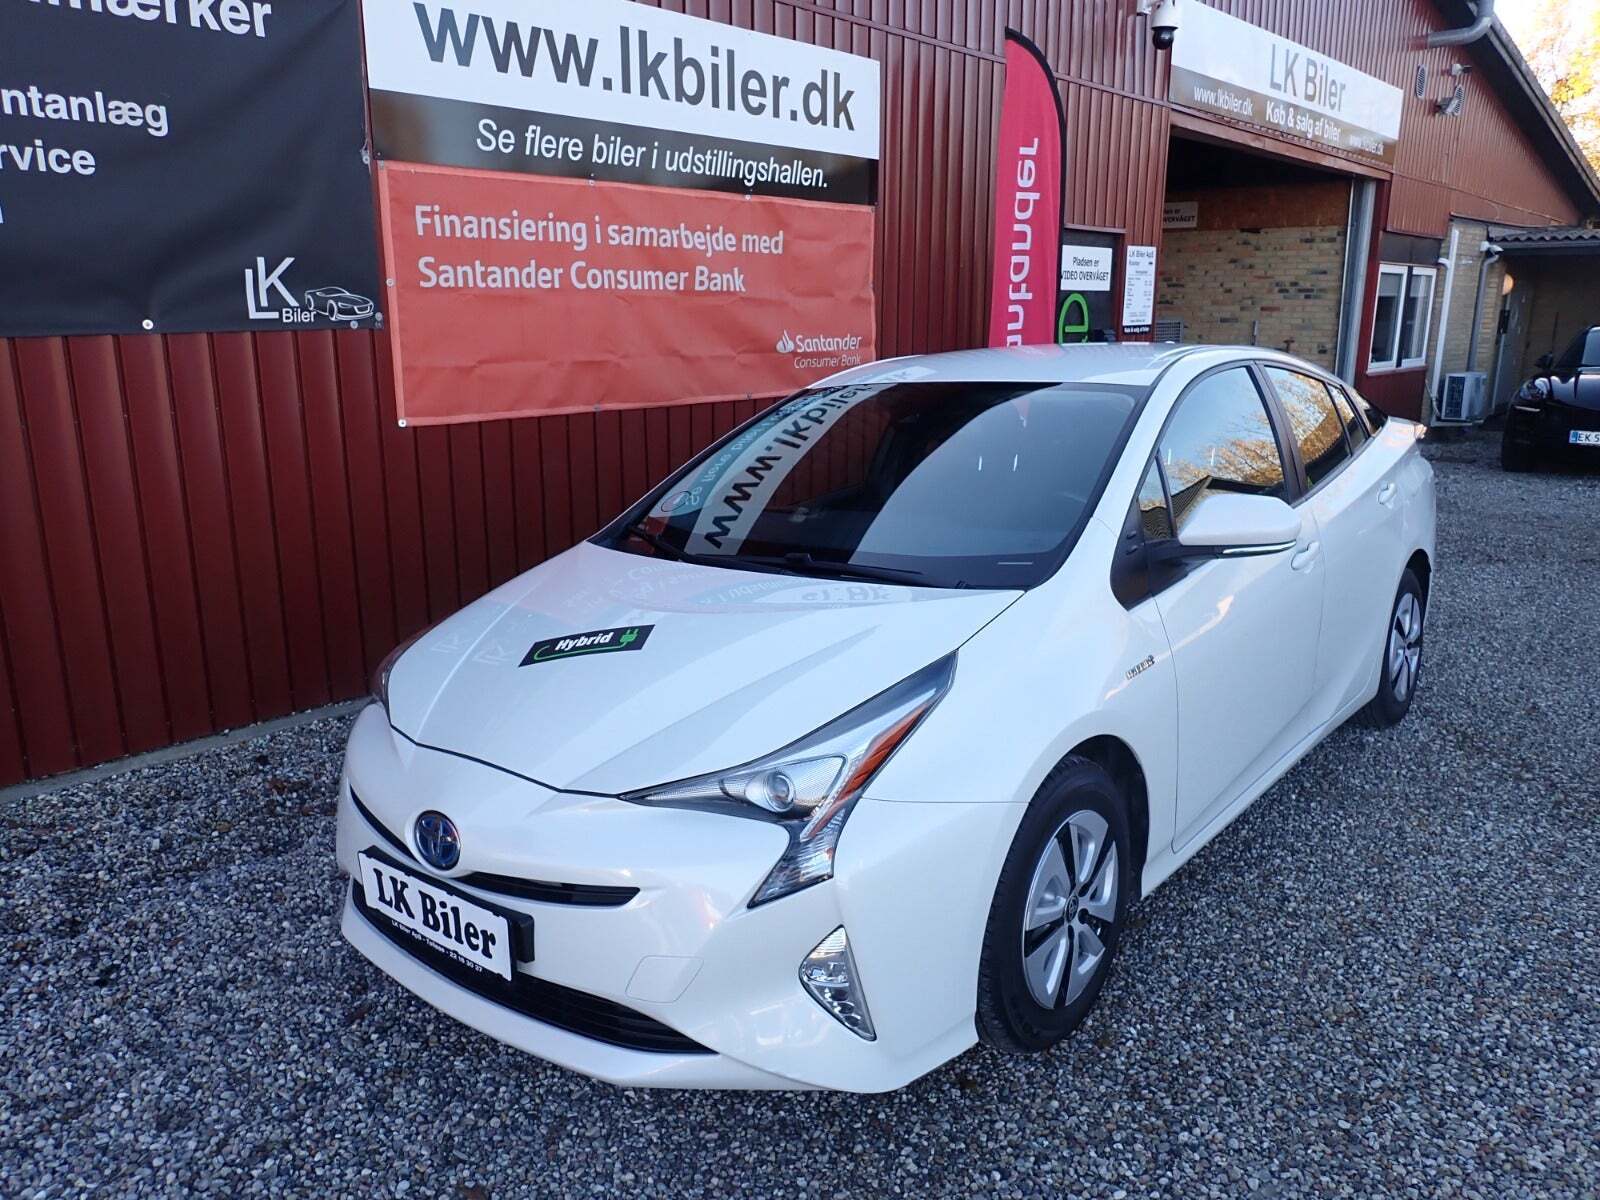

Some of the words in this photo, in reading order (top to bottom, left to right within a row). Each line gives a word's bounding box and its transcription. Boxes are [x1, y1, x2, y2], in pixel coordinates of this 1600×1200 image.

[414, 2, 855, 131] www.lkbiler.dk
[1269, 43, 1298, 98] LK
[1304, 63, 1345, 112] Biler
[1265, 100, 1286, 126] Køb
[1287, 107, 1295, 128] &
[1296, 113, 1314, 139] salg
[476, 118, 516, 153] Se
[524, 125, 583, 161] flere
[591, 134, 646, 167] biler
[651, 141, 659, 169] i
[665, 146, 828, 187] udstillingshallen.
[415, 204, 587, 252] Finansiering
[594, 215, 602, 244] i
[607, 223, 737, 258] samarbejde
[742, 230, 784, 255] med
[417, 256, 564, 290] Santander
[570, 261, 689, 291] Consumer
[694, 265, 747, 292] Bank
[1072, 256, 1093, 267] Pladsen
[245, 256, 300, 320] LK
[282, 308, 317, 323] Biler
[793, 355, 840, 368] Consumer
[841, 354, 861, 366] Bank
[796, 333, 863, 352] Santander
[1578, 432, 1591, 442] EK
[555, 632, 614, 651] Hybrid
[373, 867, 416, 920] LK
[418, 889, 497, 960] Biler
